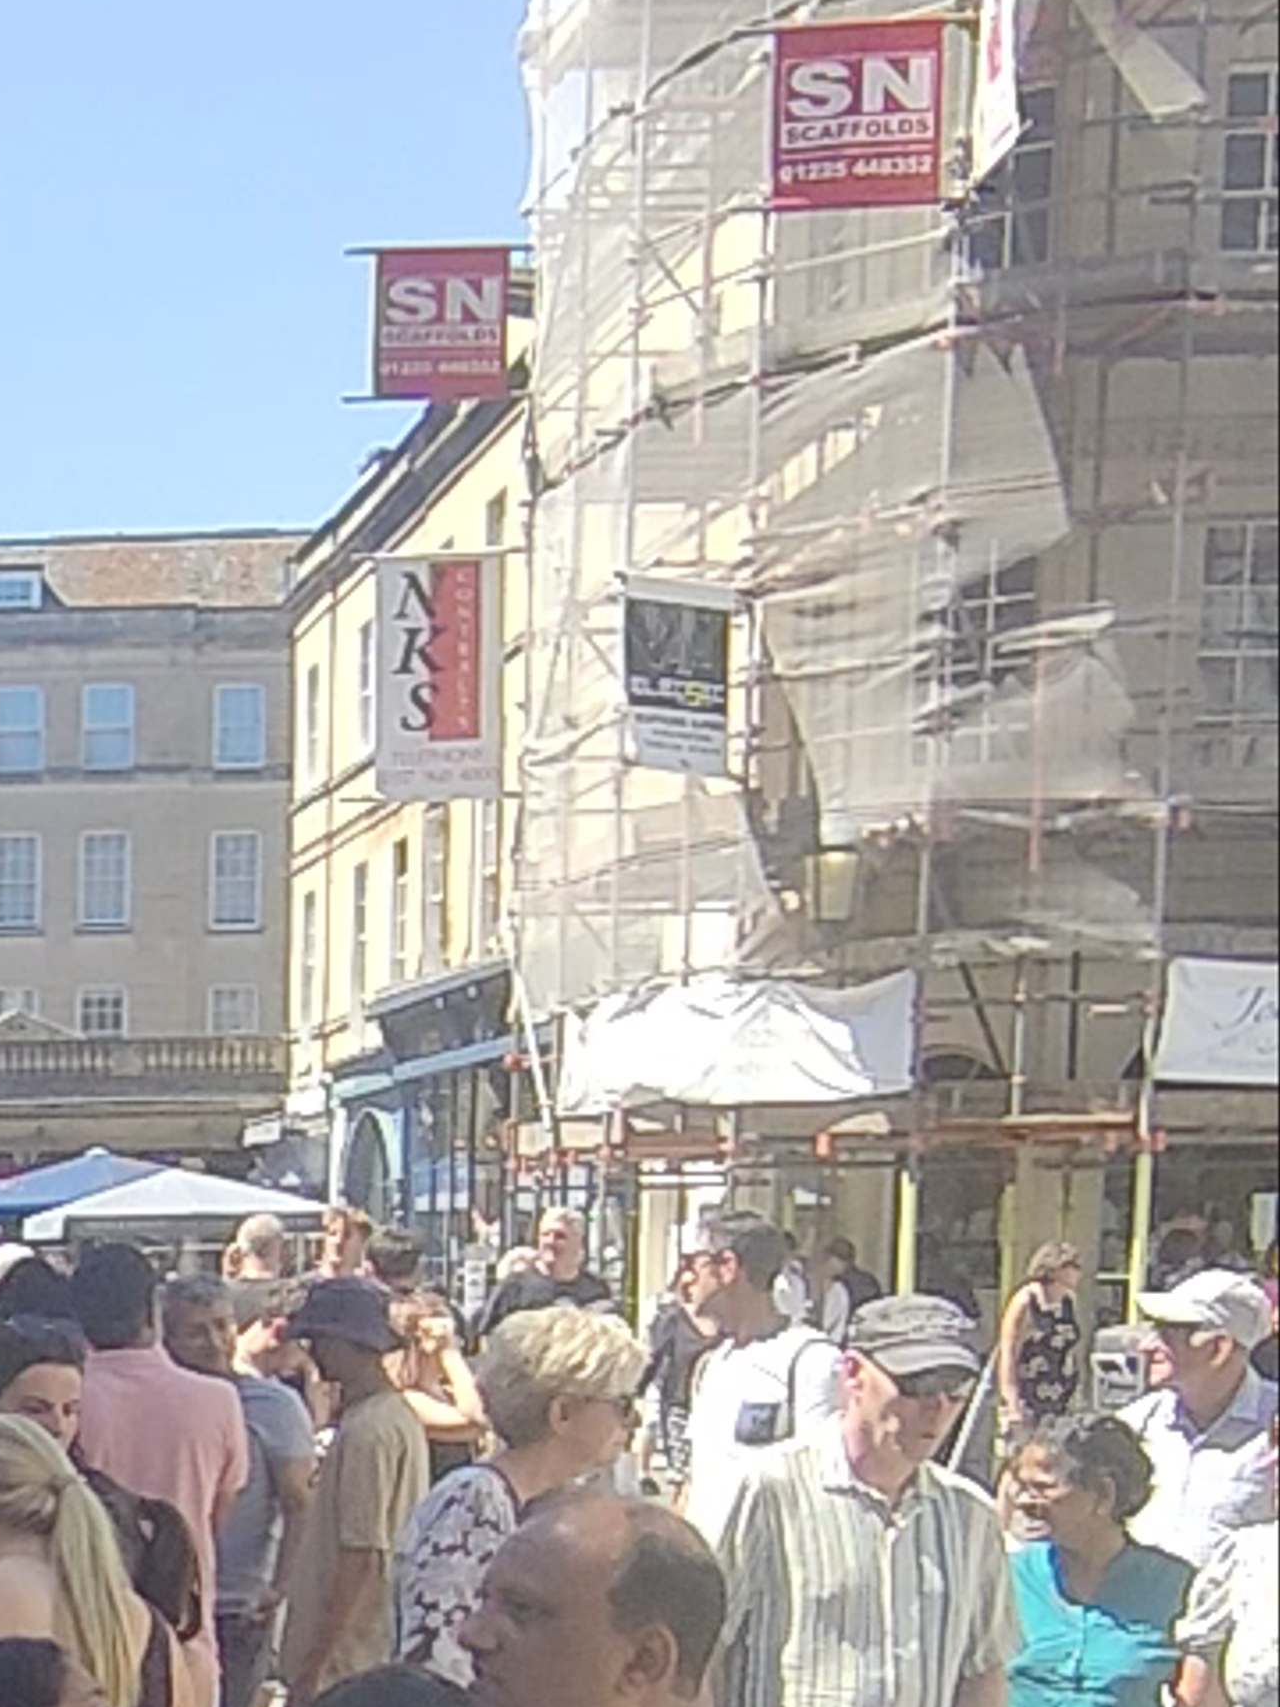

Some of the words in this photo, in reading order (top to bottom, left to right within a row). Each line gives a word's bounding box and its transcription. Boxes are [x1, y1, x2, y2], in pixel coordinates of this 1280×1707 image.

[787, 56, 932, 118] SN
[784, 118, 931, 144] SCAFFOLDS
[385, 275, 500, 324] SN
[391, 569, 447, 732] NKS
